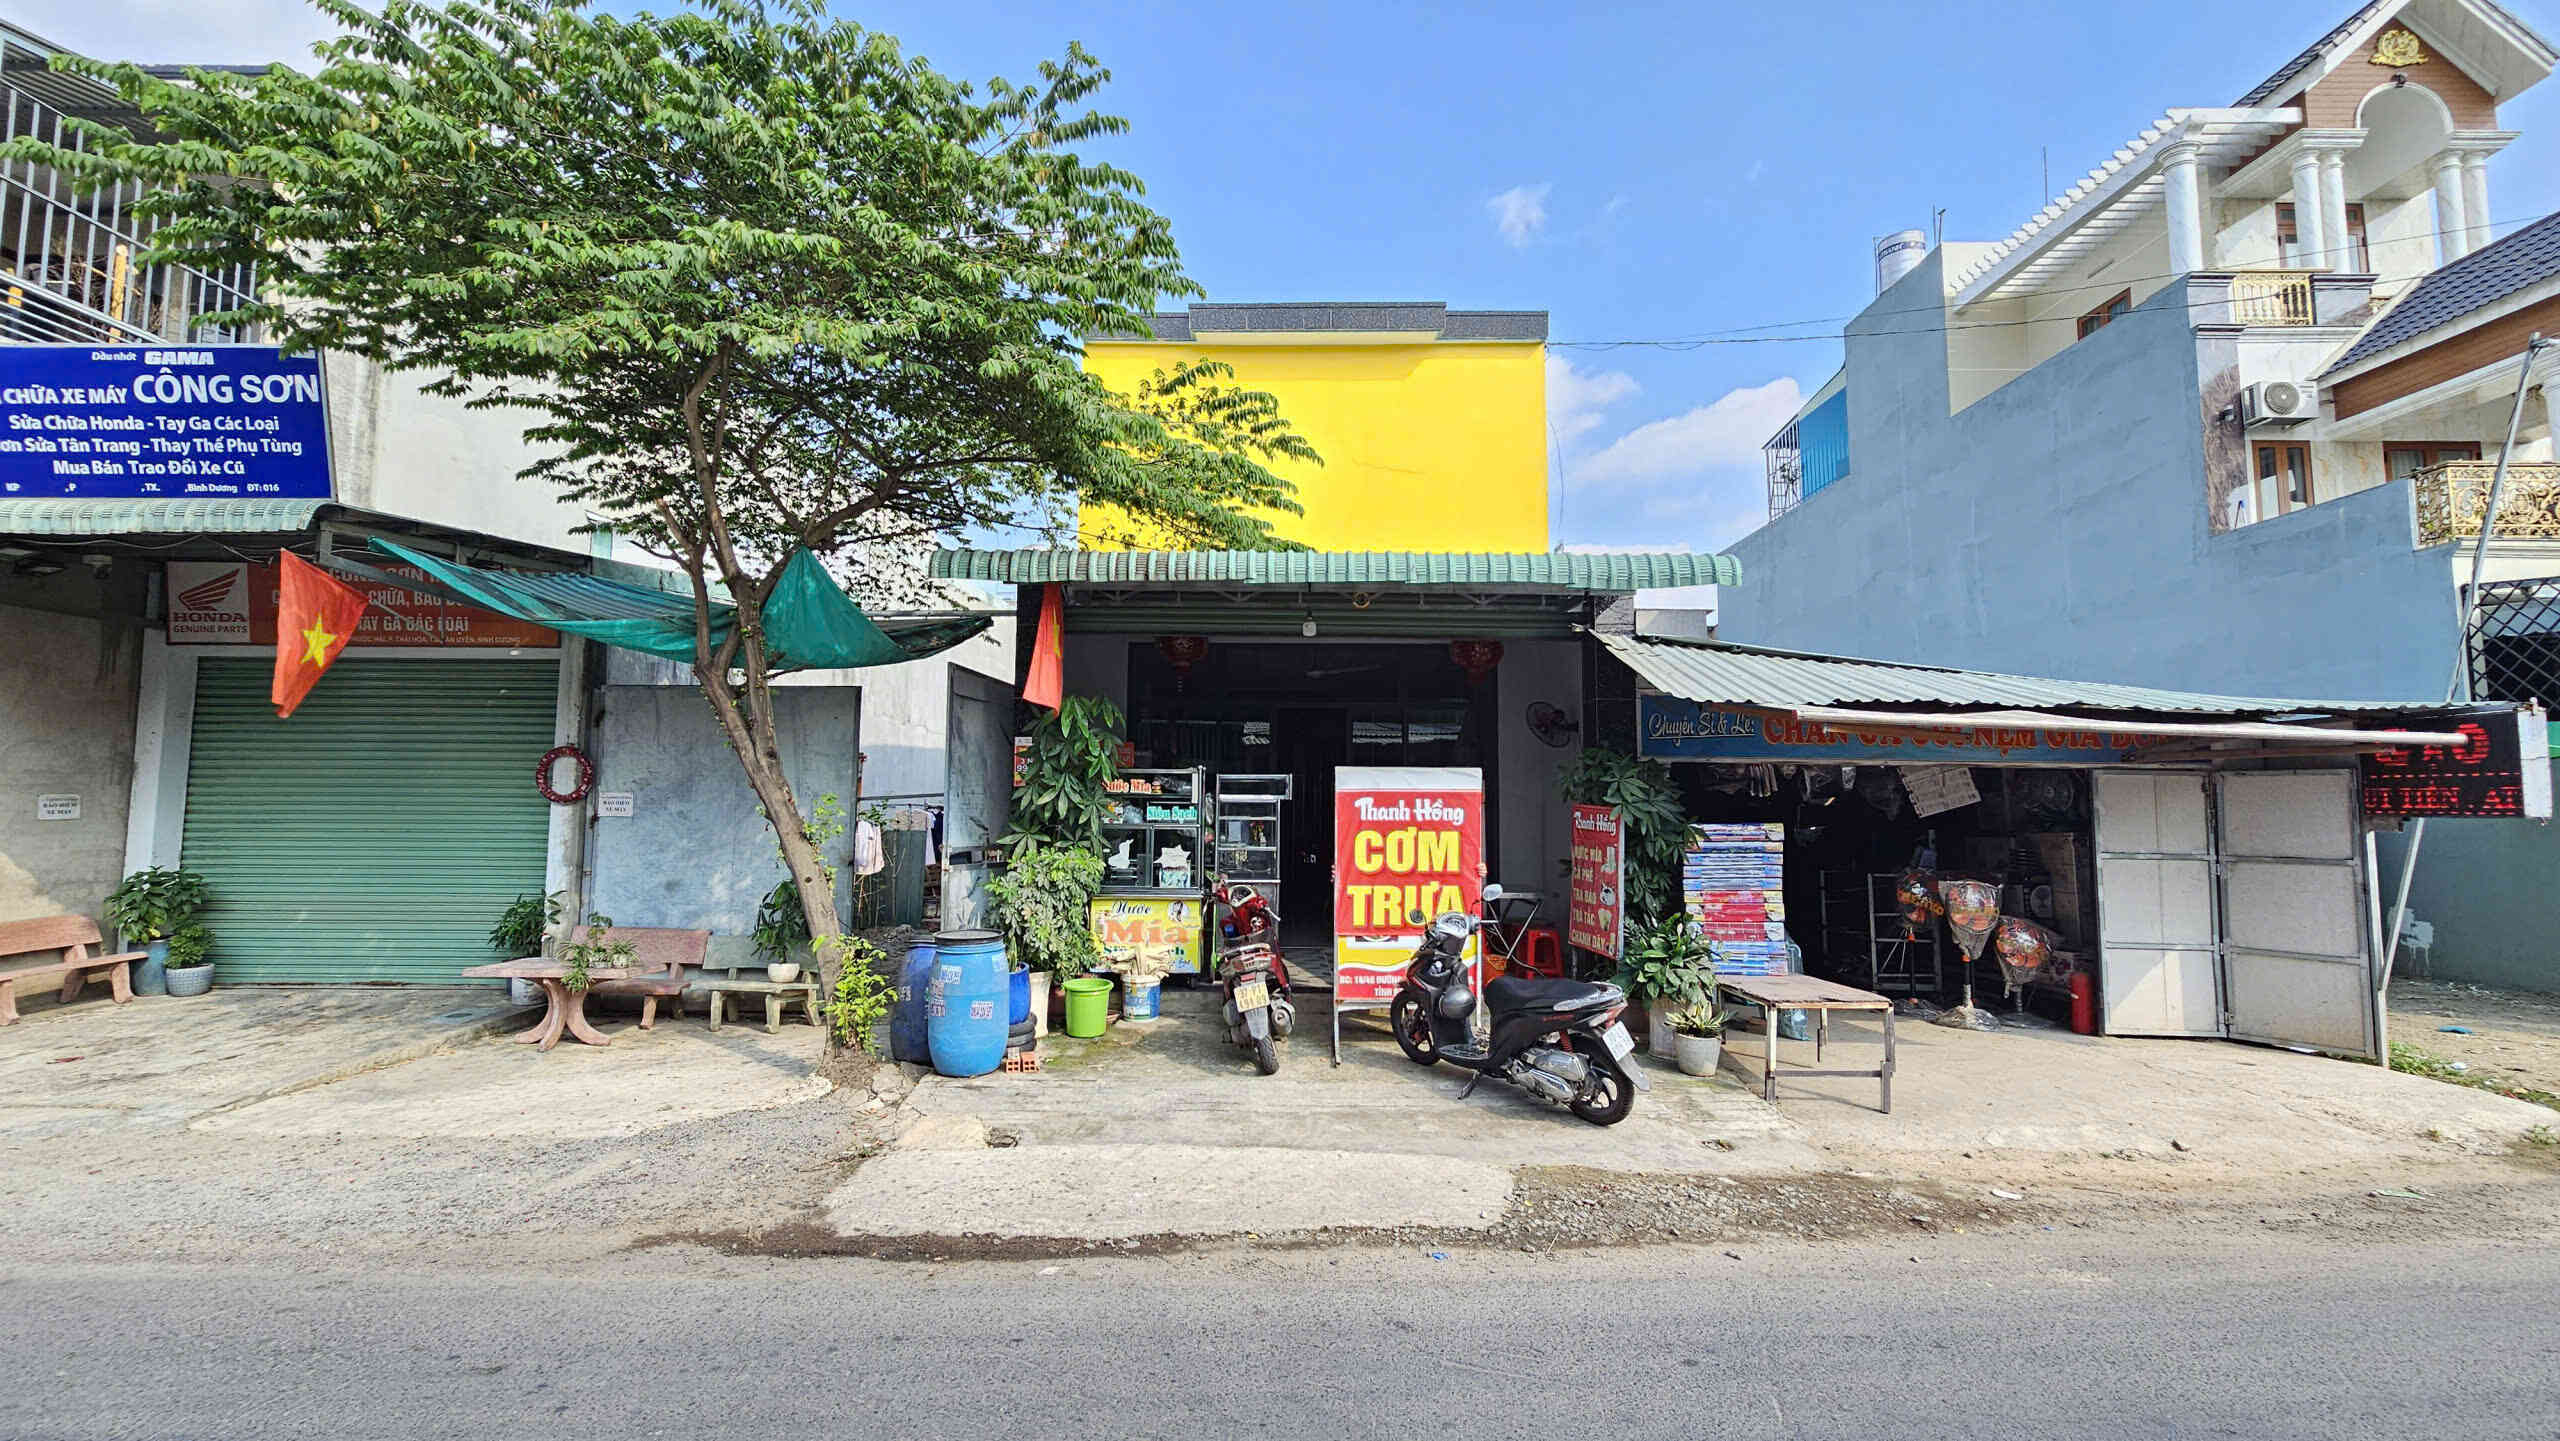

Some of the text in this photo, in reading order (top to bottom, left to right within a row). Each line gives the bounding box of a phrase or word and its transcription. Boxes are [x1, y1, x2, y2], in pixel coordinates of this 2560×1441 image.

[60, 388, 87, 405] XE
[88, 384, 128, 405] MÁY
[132, 366, 235, 404] CÔNG
[239, 373, 320, 404] SƠN
[8, 413, 43, 431] Sửa
[43, 413, 88, 431] Chữa
[89, 414, 146, 431] Honda
[155, 415, 186, 435] Tay
[188, 415, 212, 431] Ga
[213, 415, 243, 431] Các
[245, 415, 280, 434] Loại
[23, 435, 57, 452] Sửa
[57, 437, 91, 453] Tân
[91, 438, 141, 456] Trang
[150, 438, 191, 456] Thay
[192, 436, 225, 453] Thế
[226, 438, 258, 457] Phụ
[260, 438, 302, 456] Tùng
[53, 457, 246, 475] Mua Bán Trao Đổi Xe Cũ
[262, 483, 280, 492] 016
[173, 612, 247, 622] HONDA
[174, 625, 248, 633] GENUINE PARTS
[1354, 797, 1465, 826] Thanh Hồng
[1353, 826, 1461, 874] CƠM
[1346, 881, 1465, 928] TRƯA
[1103, 919, 1190, 945] Mía
